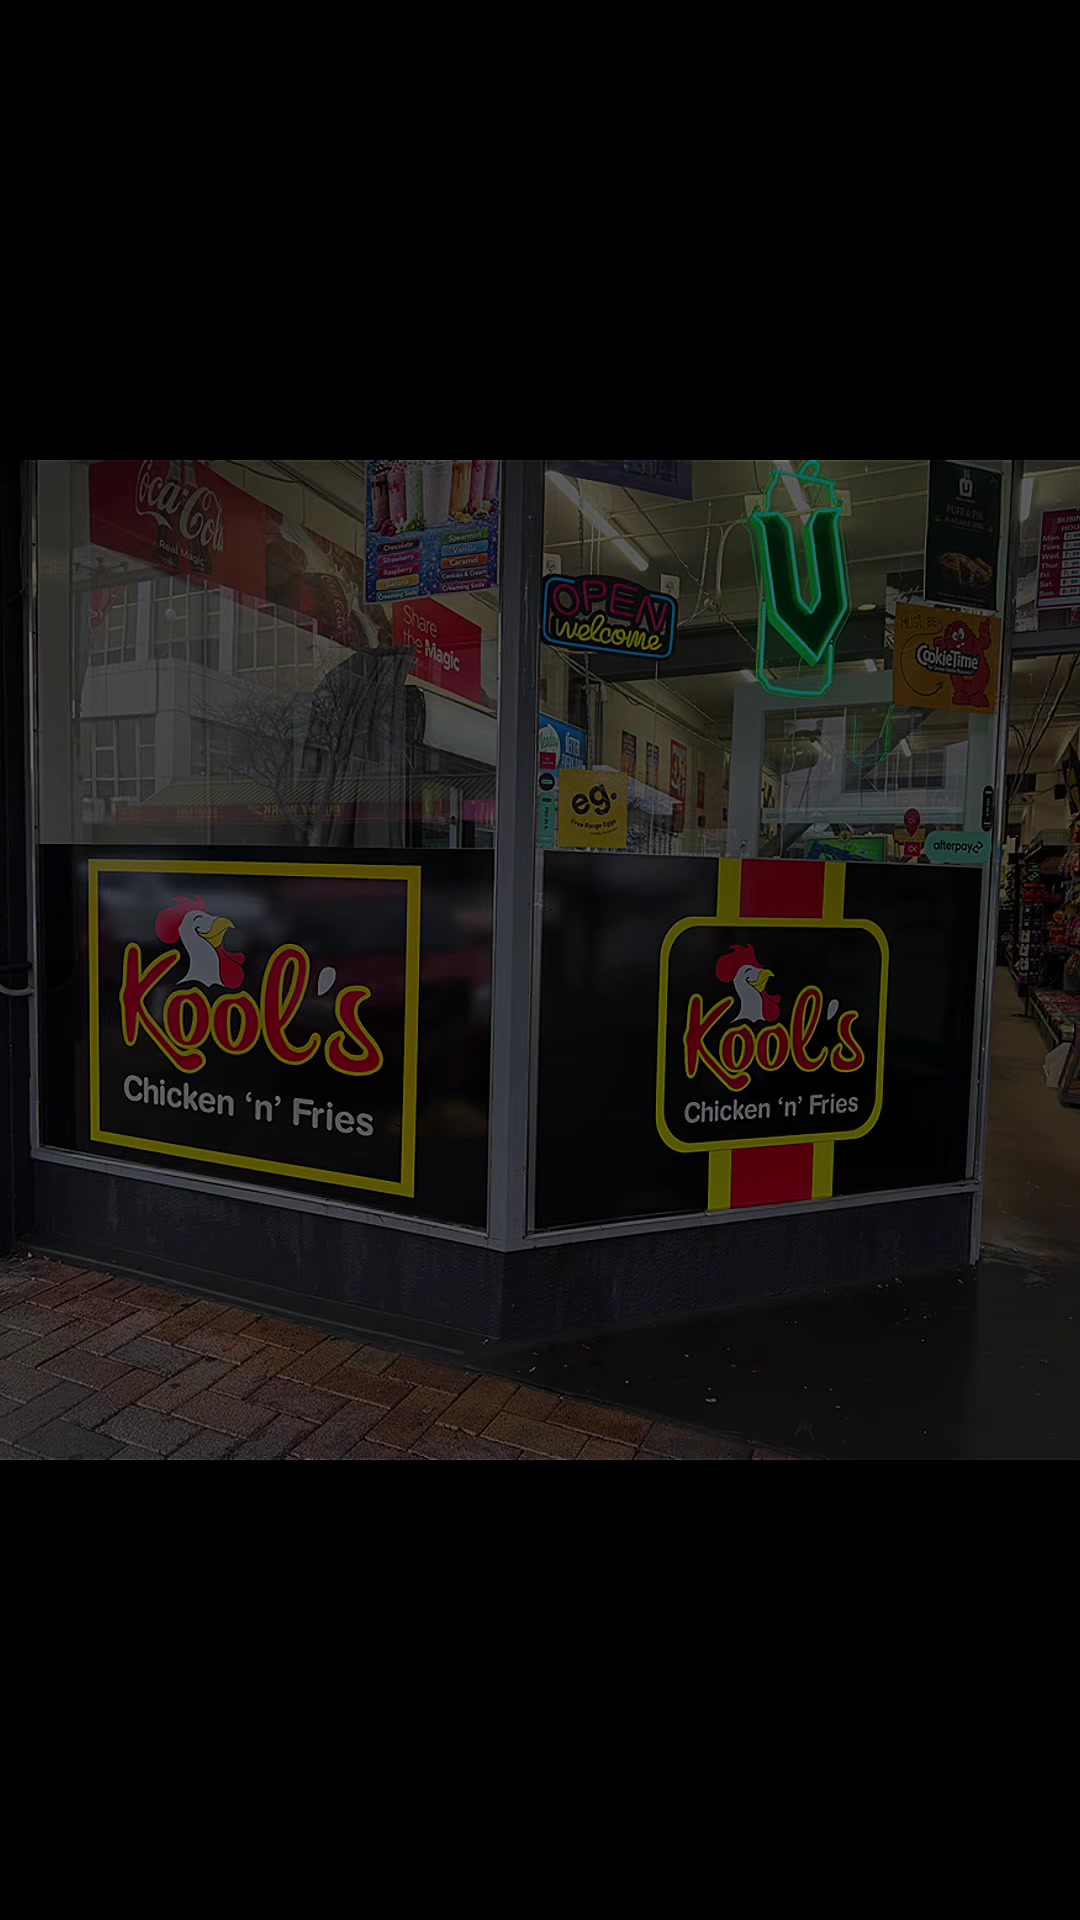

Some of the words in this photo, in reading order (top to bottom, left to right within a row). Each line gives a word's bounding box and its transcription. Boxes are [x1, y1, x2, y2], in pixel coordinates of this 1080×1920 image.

[448, 531, 482, 542] Spearmint
[159, 539, 179, 555] Real
[180, 548, 206, 567] Magic
[383, 541, 414, 552] Chocolate
[452, 545, 477, 554] Vanilla
[382, 554, 415, 565] Strawberry
[449, 558, 480, 567] Caramel
[382, 566, 414, 576] Raspberry
[441, 571, 462, 580] Cookies
[468, 568, 487, 577] Cream
[441, 584, 470, 593] Creaming
[470, 581, 485, 590] Soda
[378, 590, 403, 600] Creaming
[553, 579, 670, 631] OPEN
[403, 605, 438, 638] Share
[900, 615, 922, 630] MUST
[926, 616, 937, 628] BE
[555, 613, 664, 651] welcome
[403, 629, 423, 653] the
[424, 638, 461, 672] Magic
[570, 818, 584, 828] Free
[584, 821, 603, 831] Range
[602, 819, 617, 828] Eggs
[933, 840, 973, 853] afterpay
[119, 942, 384, 1077] Kool's
[683, 985, 865, 1092] Kool's
[122, 1074, 236, 1116] Chicken
[292, 1096, 375, 1137] Fries
[683, 1098, 771, 1124] Chicken
[809, 1092, 860, 1115] Fries
